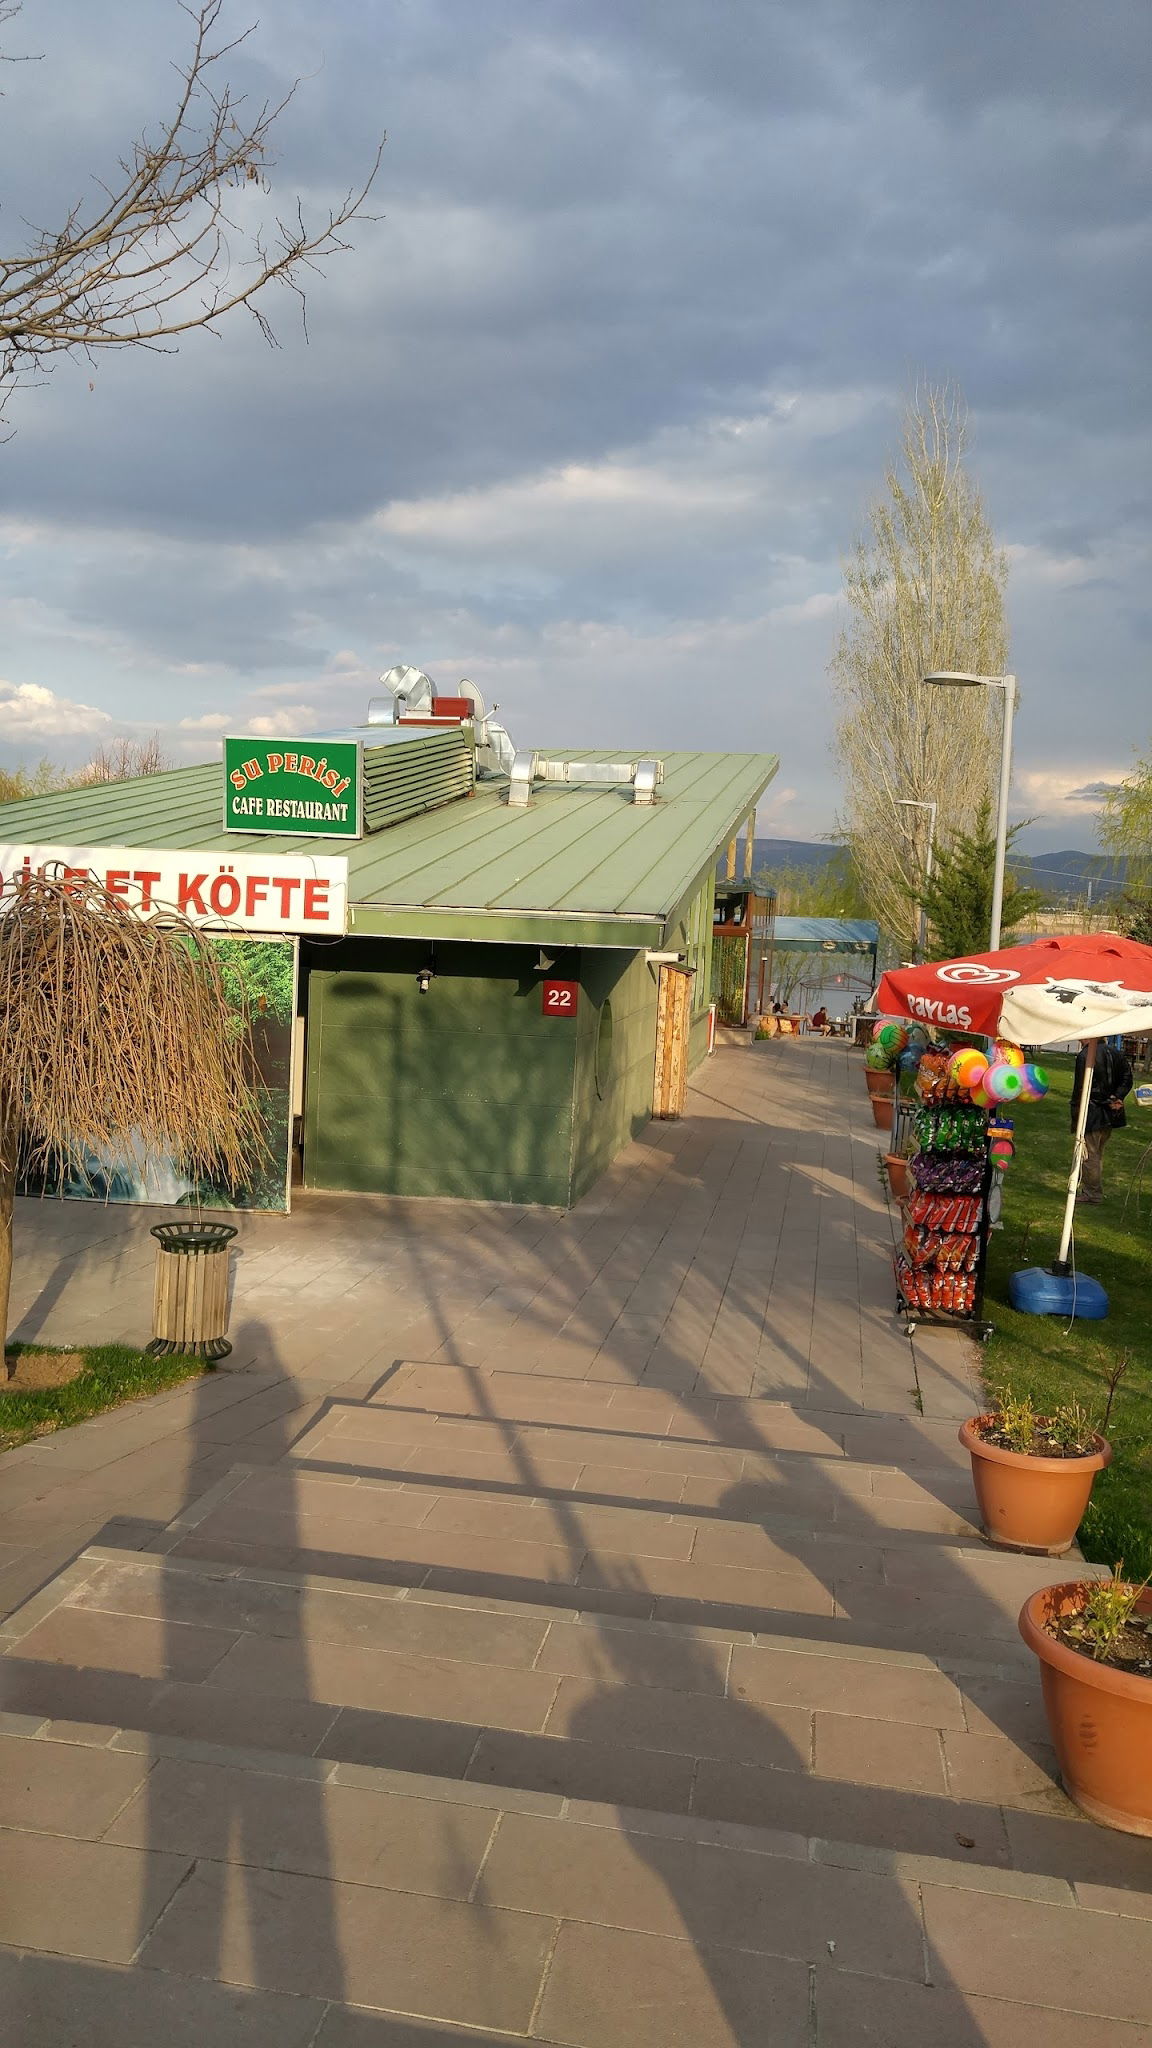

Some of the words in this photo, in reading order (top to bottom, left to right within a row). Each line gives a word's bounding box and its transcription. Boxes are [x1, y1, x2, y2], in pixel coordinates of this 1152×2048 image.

[230, 757, 264, 790] SU
[266, 752, 351, 798] PERİSİ
[232, 796, 264, 816] CAFE
[266, 798, 349, 822] RESTAURANT
[105, 870, 161, 911] ET
[178, 865, 330, 920] KÖFTE
[548, 989, 571, 1007] 22
